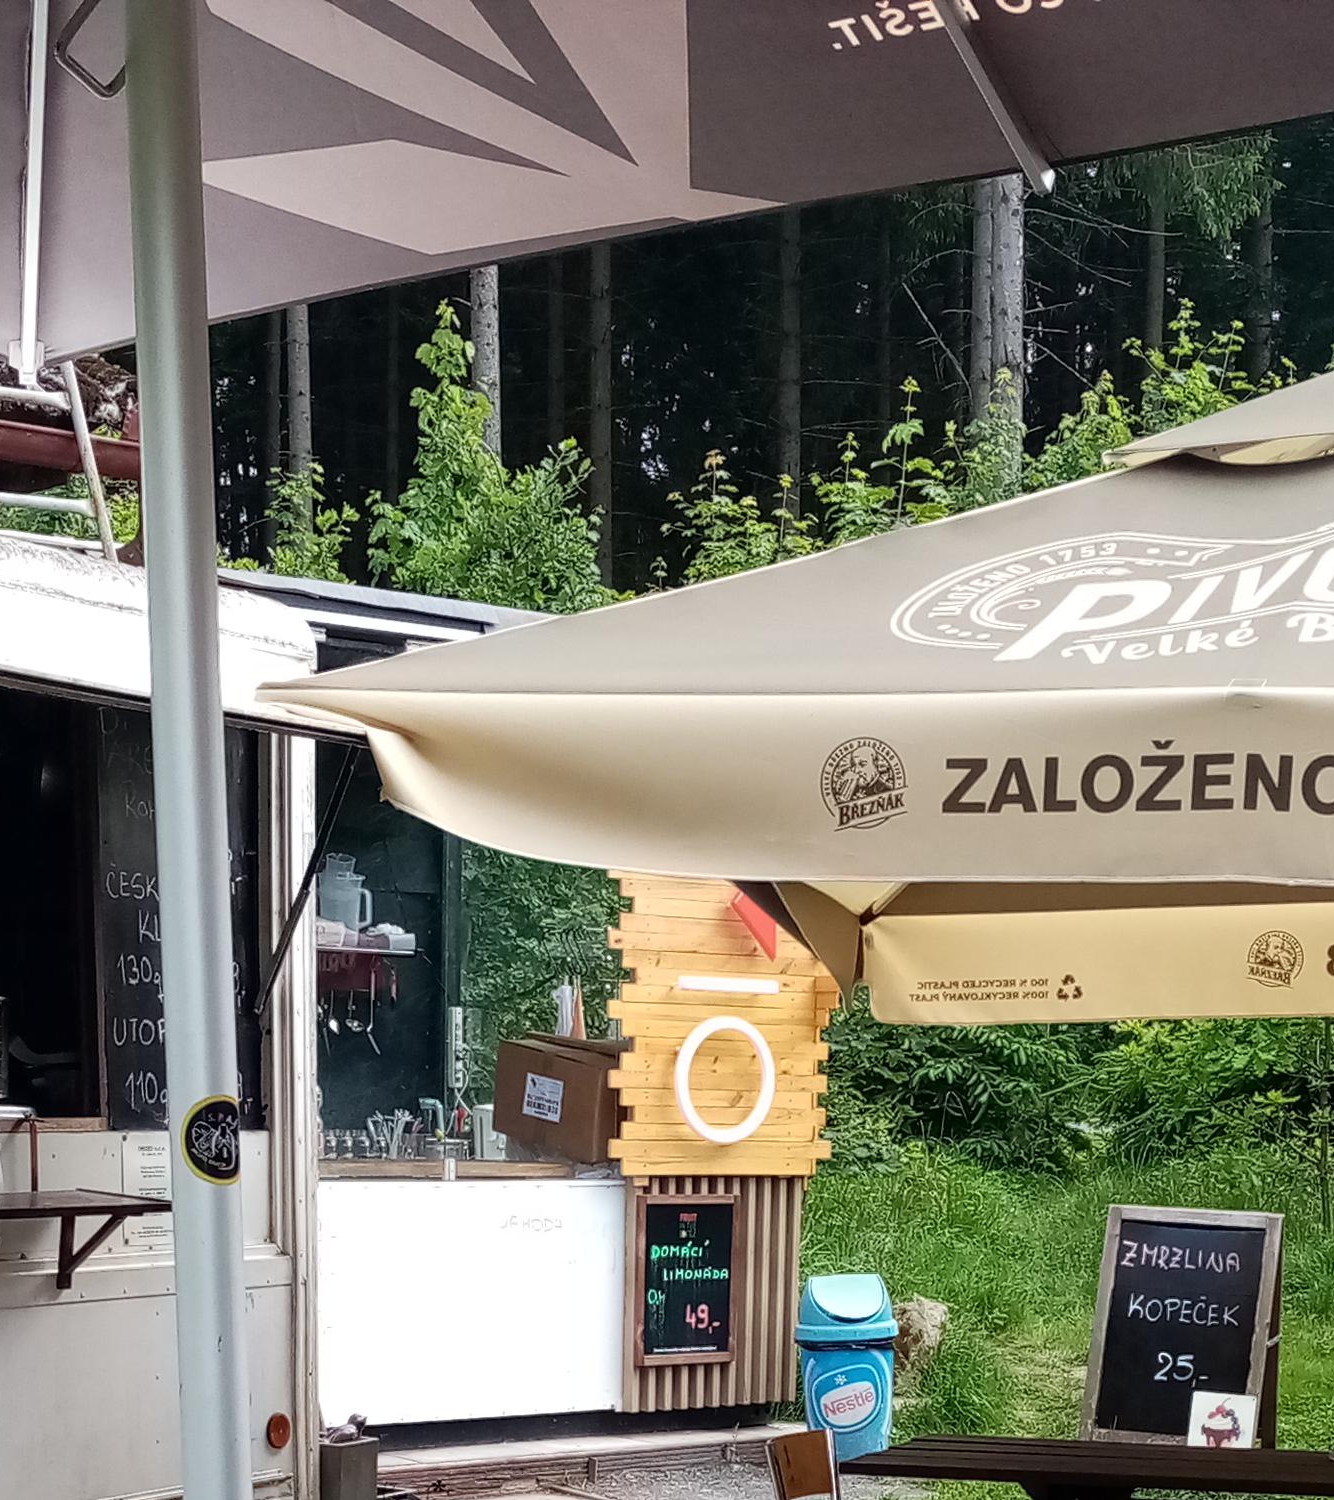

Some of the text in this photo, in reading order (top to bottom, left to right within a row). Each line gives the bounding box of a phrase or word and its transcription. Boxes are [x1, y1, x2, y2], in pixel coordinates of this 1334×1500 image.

[927, 542, 1118, 619] ZALOŽENO 1753
[1060, 619, 1259, 666] Velké
[838, 792, 905, 828] BŘEZŇÁK
[650, 1239, 710, 1260] DOMÁCÍ
[1120, 1240, 1241, 1273] ZMRZLINA
[663, 1266, 729, 1281] LIMONÁDA
[685, 1303, 721, 1334] 49,-
[1127, 1292, 1241, 1327] KOPEČEK
[1153, 1352, 1209, 1388] 25,-
[823, 1388, 874, 1417] Nestlé
